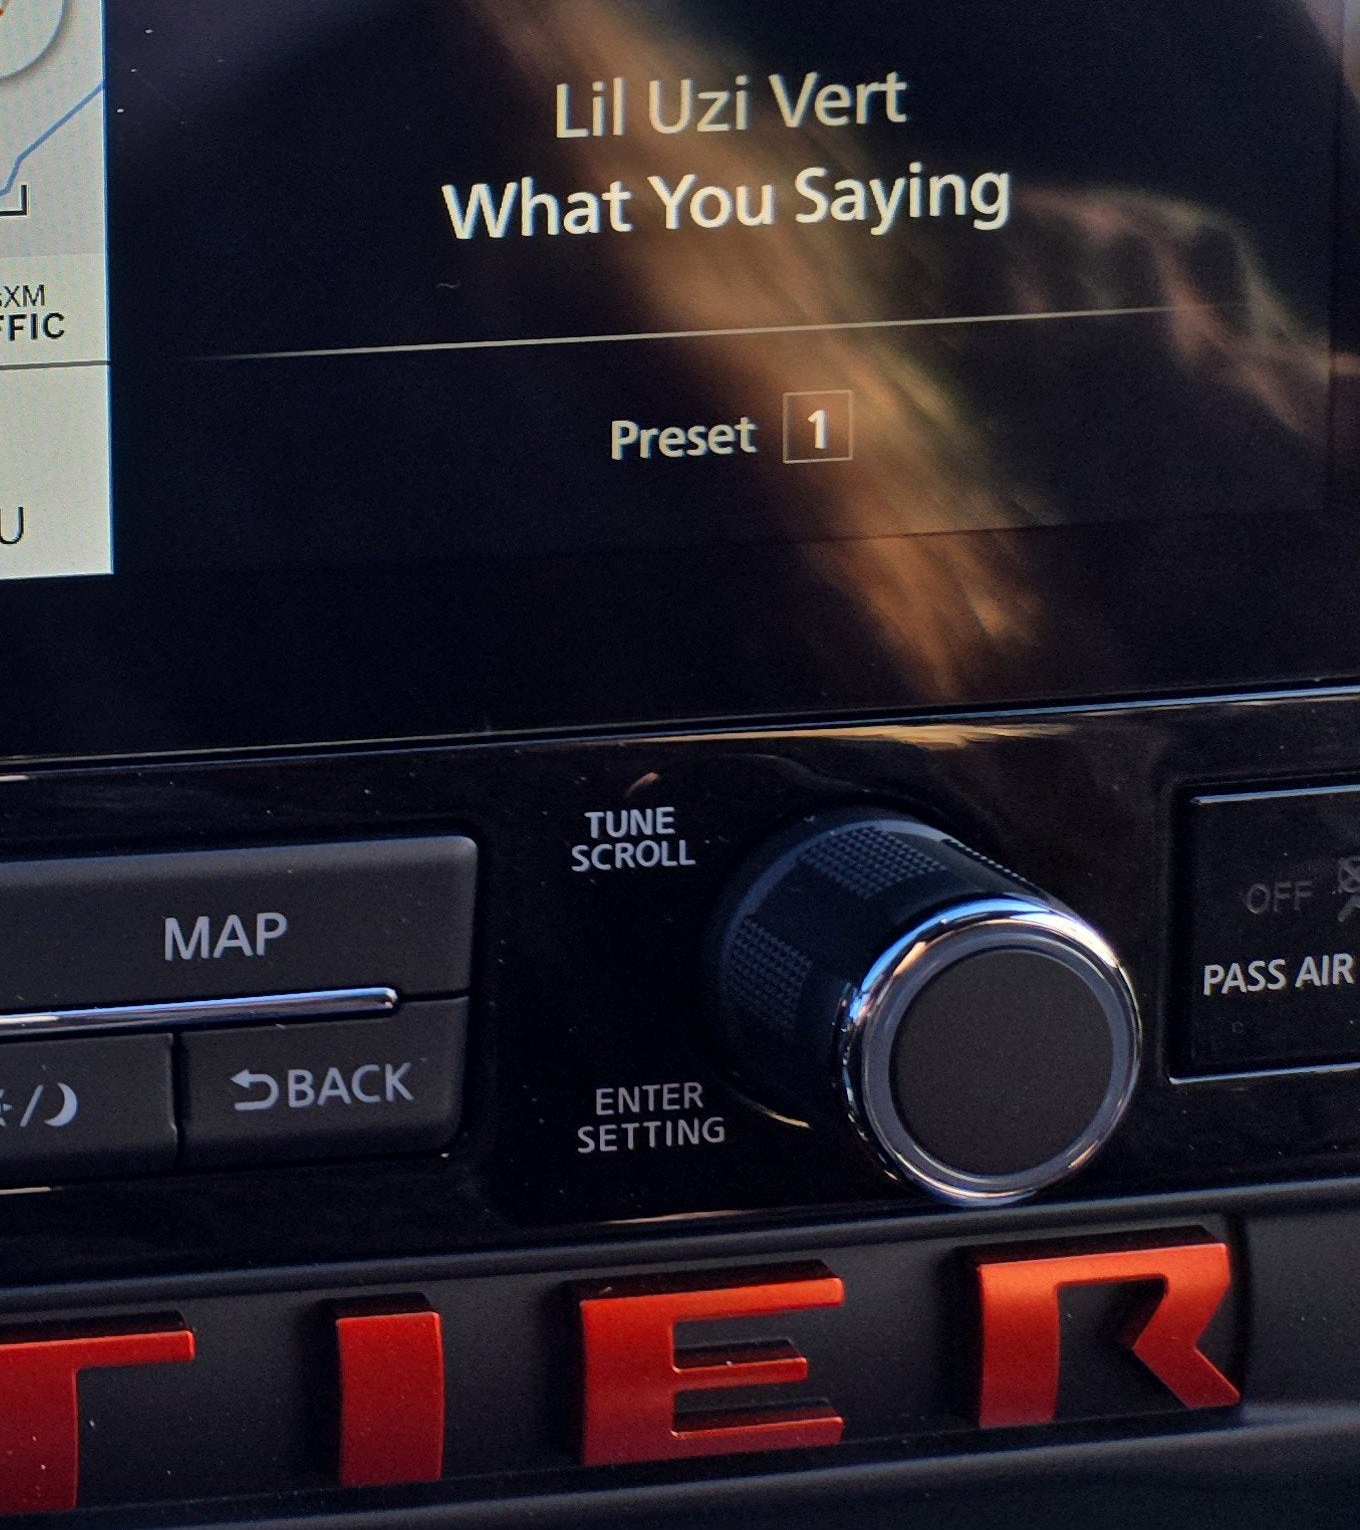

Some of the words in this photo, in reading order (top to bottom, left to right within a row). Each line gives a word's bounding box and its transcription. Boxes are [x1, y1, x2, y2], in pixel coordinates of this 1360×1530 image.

[556, 77, 624, 138] Lil
[649, 76, 748, 134] Uzi
[769, 72, 907, 128] Vert
[442, 176, 632, 239] What
[648, 174, 775, 230] You
[794, 162, 1011, 236] Saying
[611, 417, 757, 460] Preset
[807, 409, 827, 449] 1
[585, 806, 676, 839] TUNE
[571, 840, 696, 872] SCROLL
[1245, 882, 1313, 915] OFF
[164, 912, 288, 961] MAP
[1203, 960, 1286, 996] PASS
[1295, 954, 1354, 988] AIR
[288, 1063, 412, 1109] BACK
[596, 1082, 704, 1115] ENTER
[577, 1117, 725, 1153] SETTING
